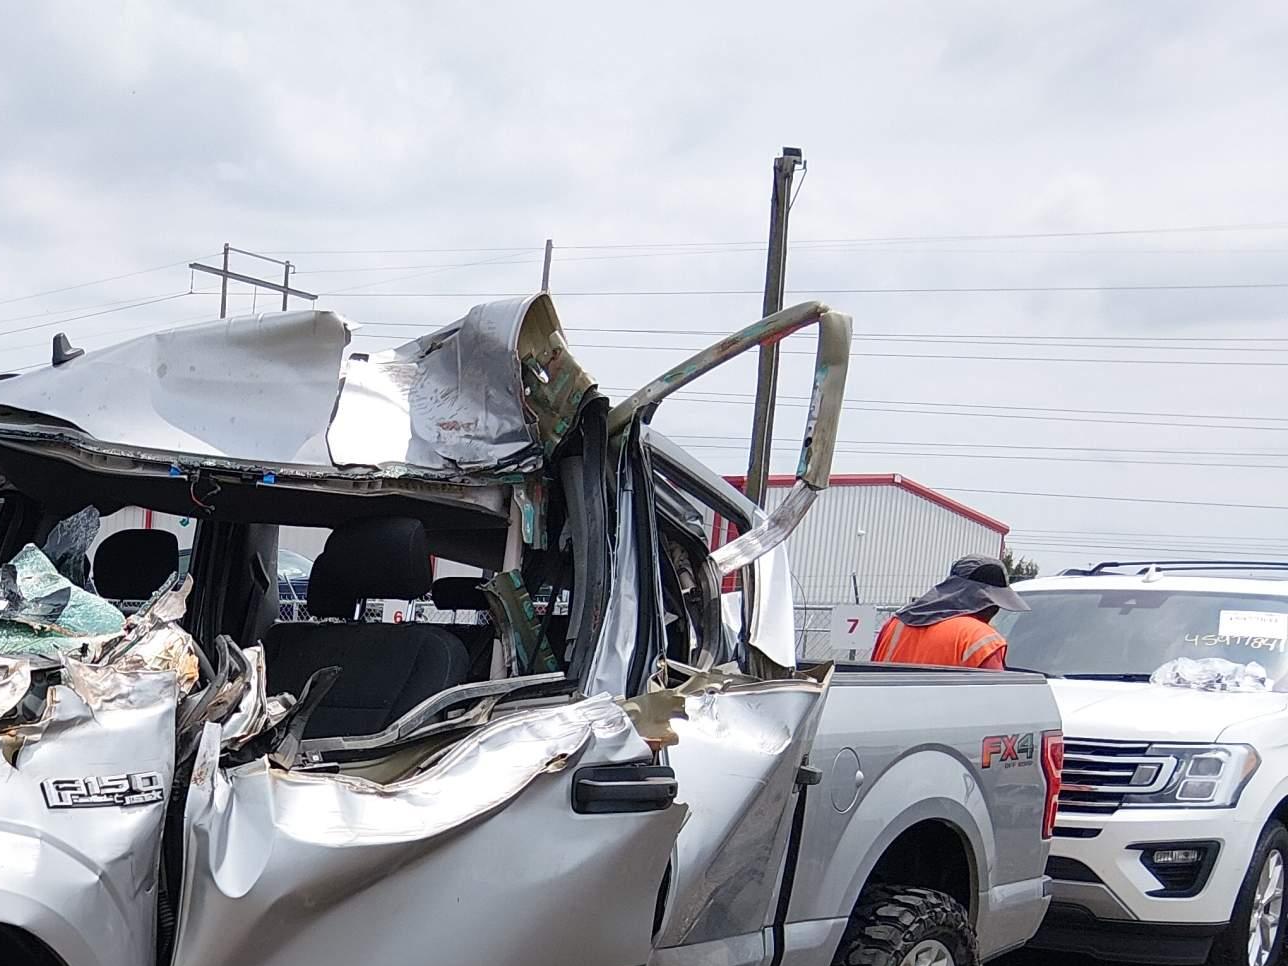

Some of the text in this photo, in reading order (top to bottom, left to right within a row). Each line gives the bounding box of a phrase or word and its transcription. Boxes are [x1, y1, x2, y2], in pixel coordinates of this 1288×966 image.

[393, 610, 403, 624] 6
[847, 619, 859, 634] 7
[981, 733, 1034, 769] FX4
